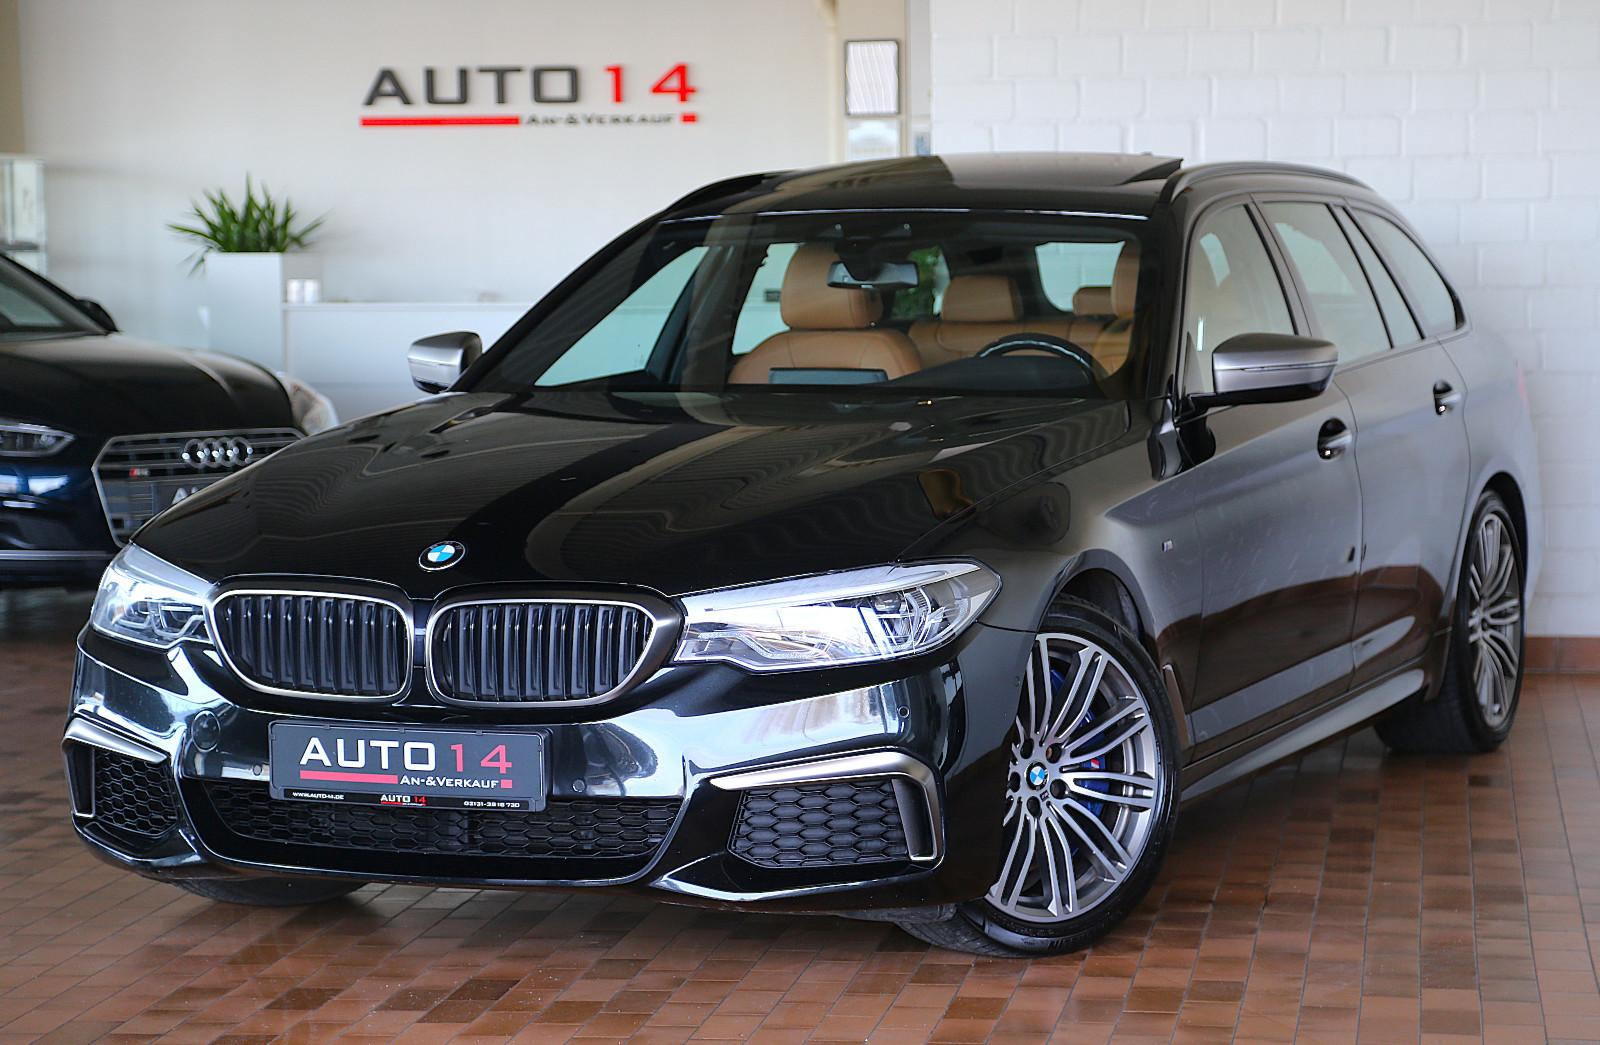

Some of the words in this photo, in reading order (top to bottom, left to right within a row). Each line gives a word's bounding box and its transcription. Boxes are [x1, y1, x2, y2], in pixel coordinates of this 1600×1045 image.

[363, 67, 579, 106] AUTO
[604, 63, 697, 103] 14
[300, 737, 436, 771] AUTO
[450, 743, 513, 774] 14
[380, 794, 411, 803] AUTO
[413, 795, 426, 803] 14
